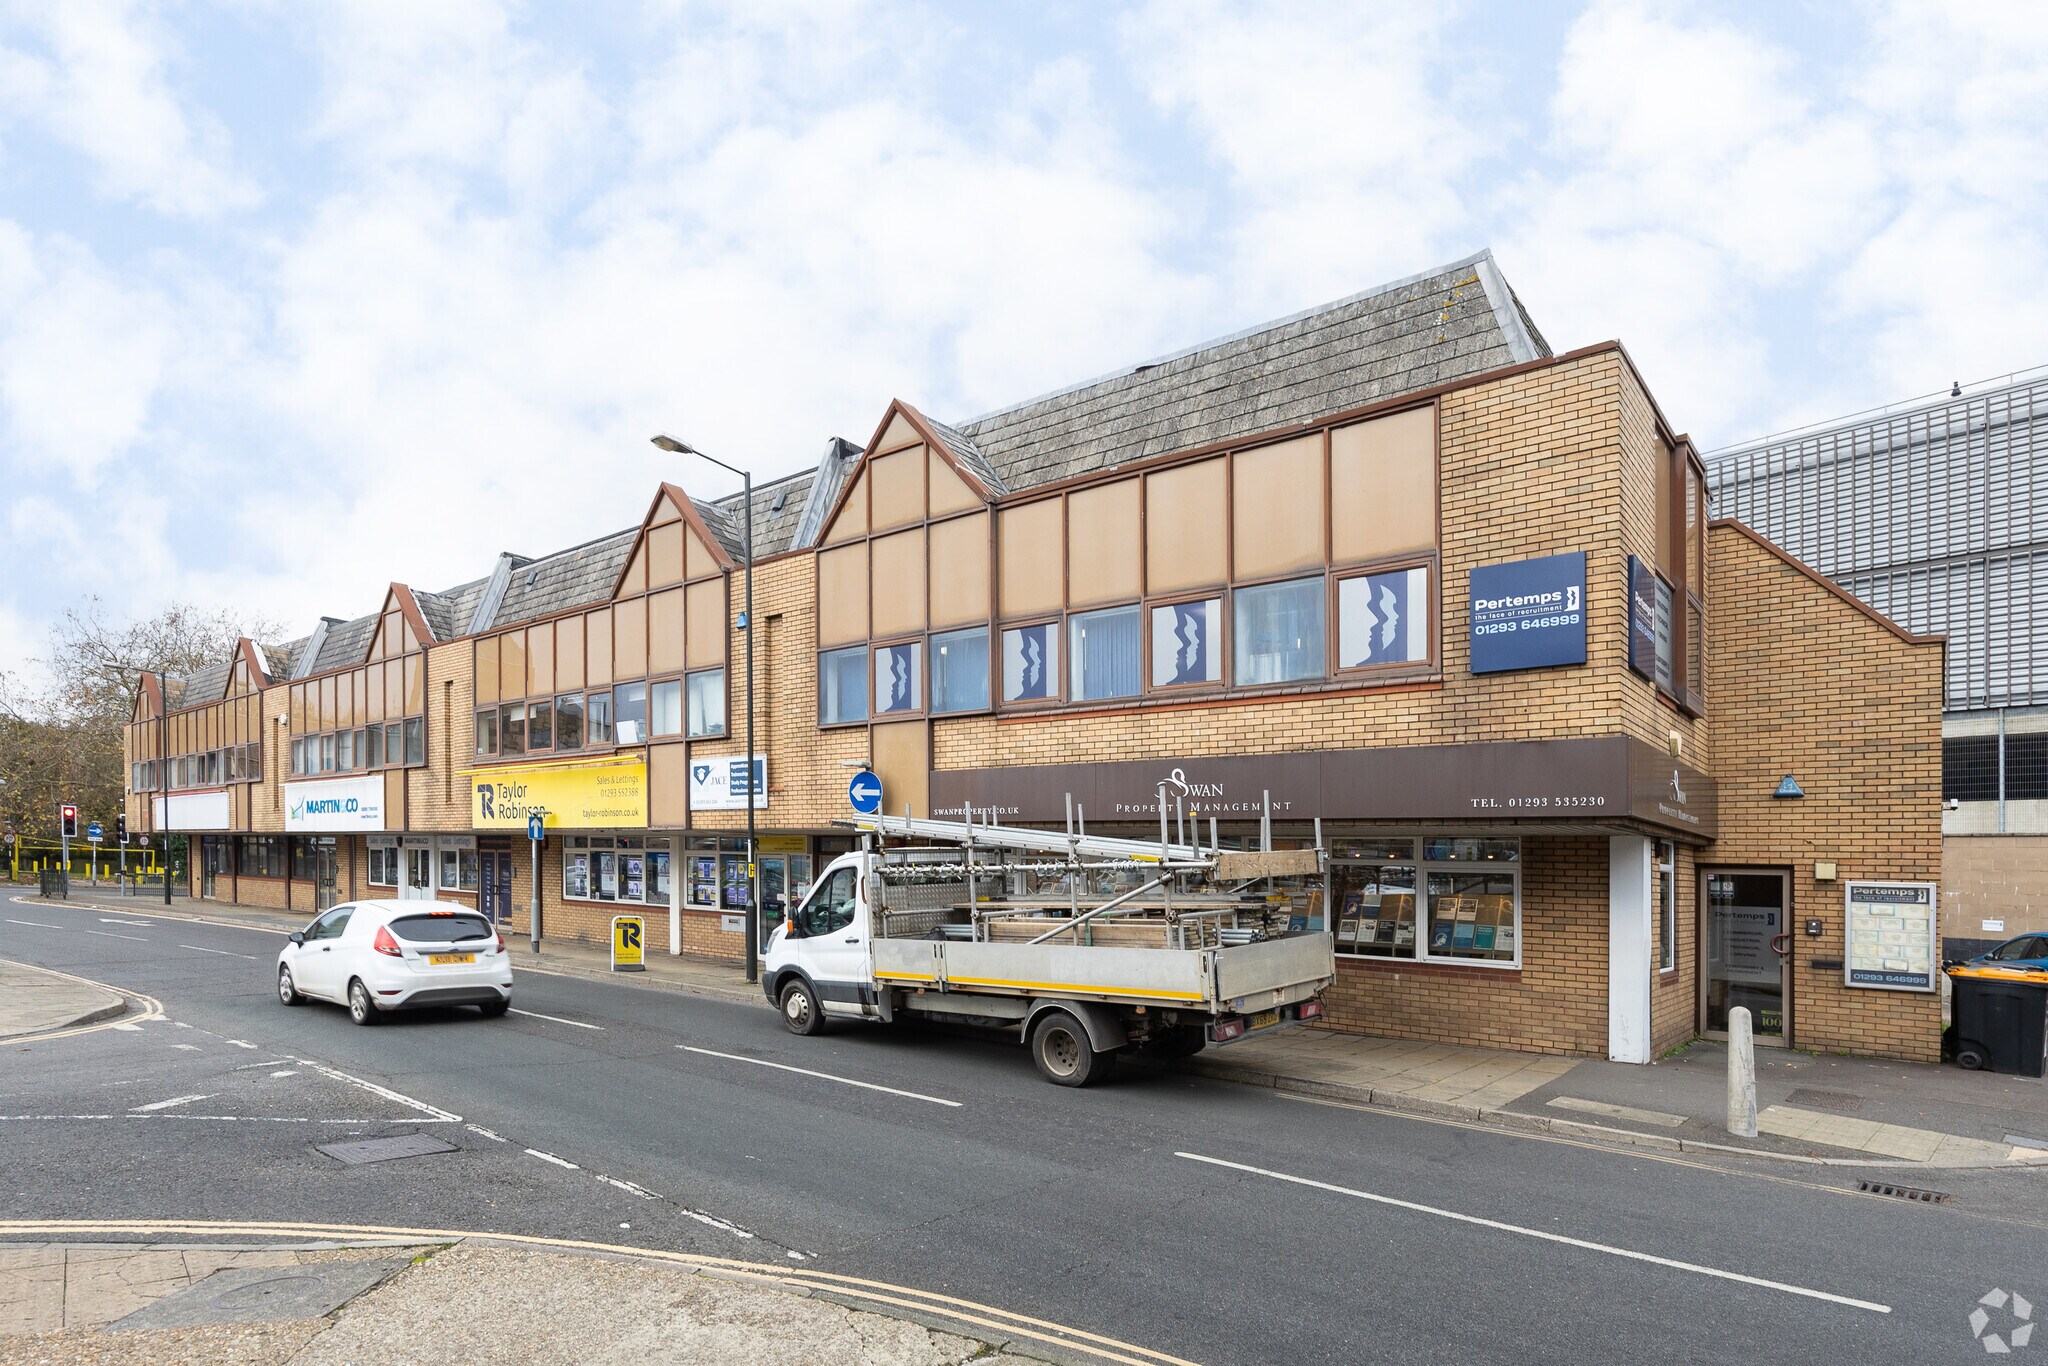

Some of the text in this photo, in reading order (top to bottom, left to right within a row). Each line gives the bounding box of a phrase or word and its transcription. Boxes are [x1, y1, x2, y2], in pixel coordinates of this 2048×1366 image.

[1475, 591, 1562, 611] Pertemps
[1517, 605, 1562, 616] recruitment
[1475, 614, 1580, 635] 01293 646999
[597, 774, 639, 785] Sales & Lettings
[710, 776, 728, 786] JACE
[497, 781, 527, 802] Taylor
[600, 787, 639, 798] 01293 552388
[1116, 802, 1291, 813] PROPET MANAGEMNT
[1470, 796, 1605, 808] TEL. 01293 535230
[582, 808, 639, 820] taylor-robinson.co.uk
[1853, 887, 1915, 897] Pertemps
[1715, 911, 1765, 920] Pertemps
[1853, 972, 1927, 985] 01293 646999
